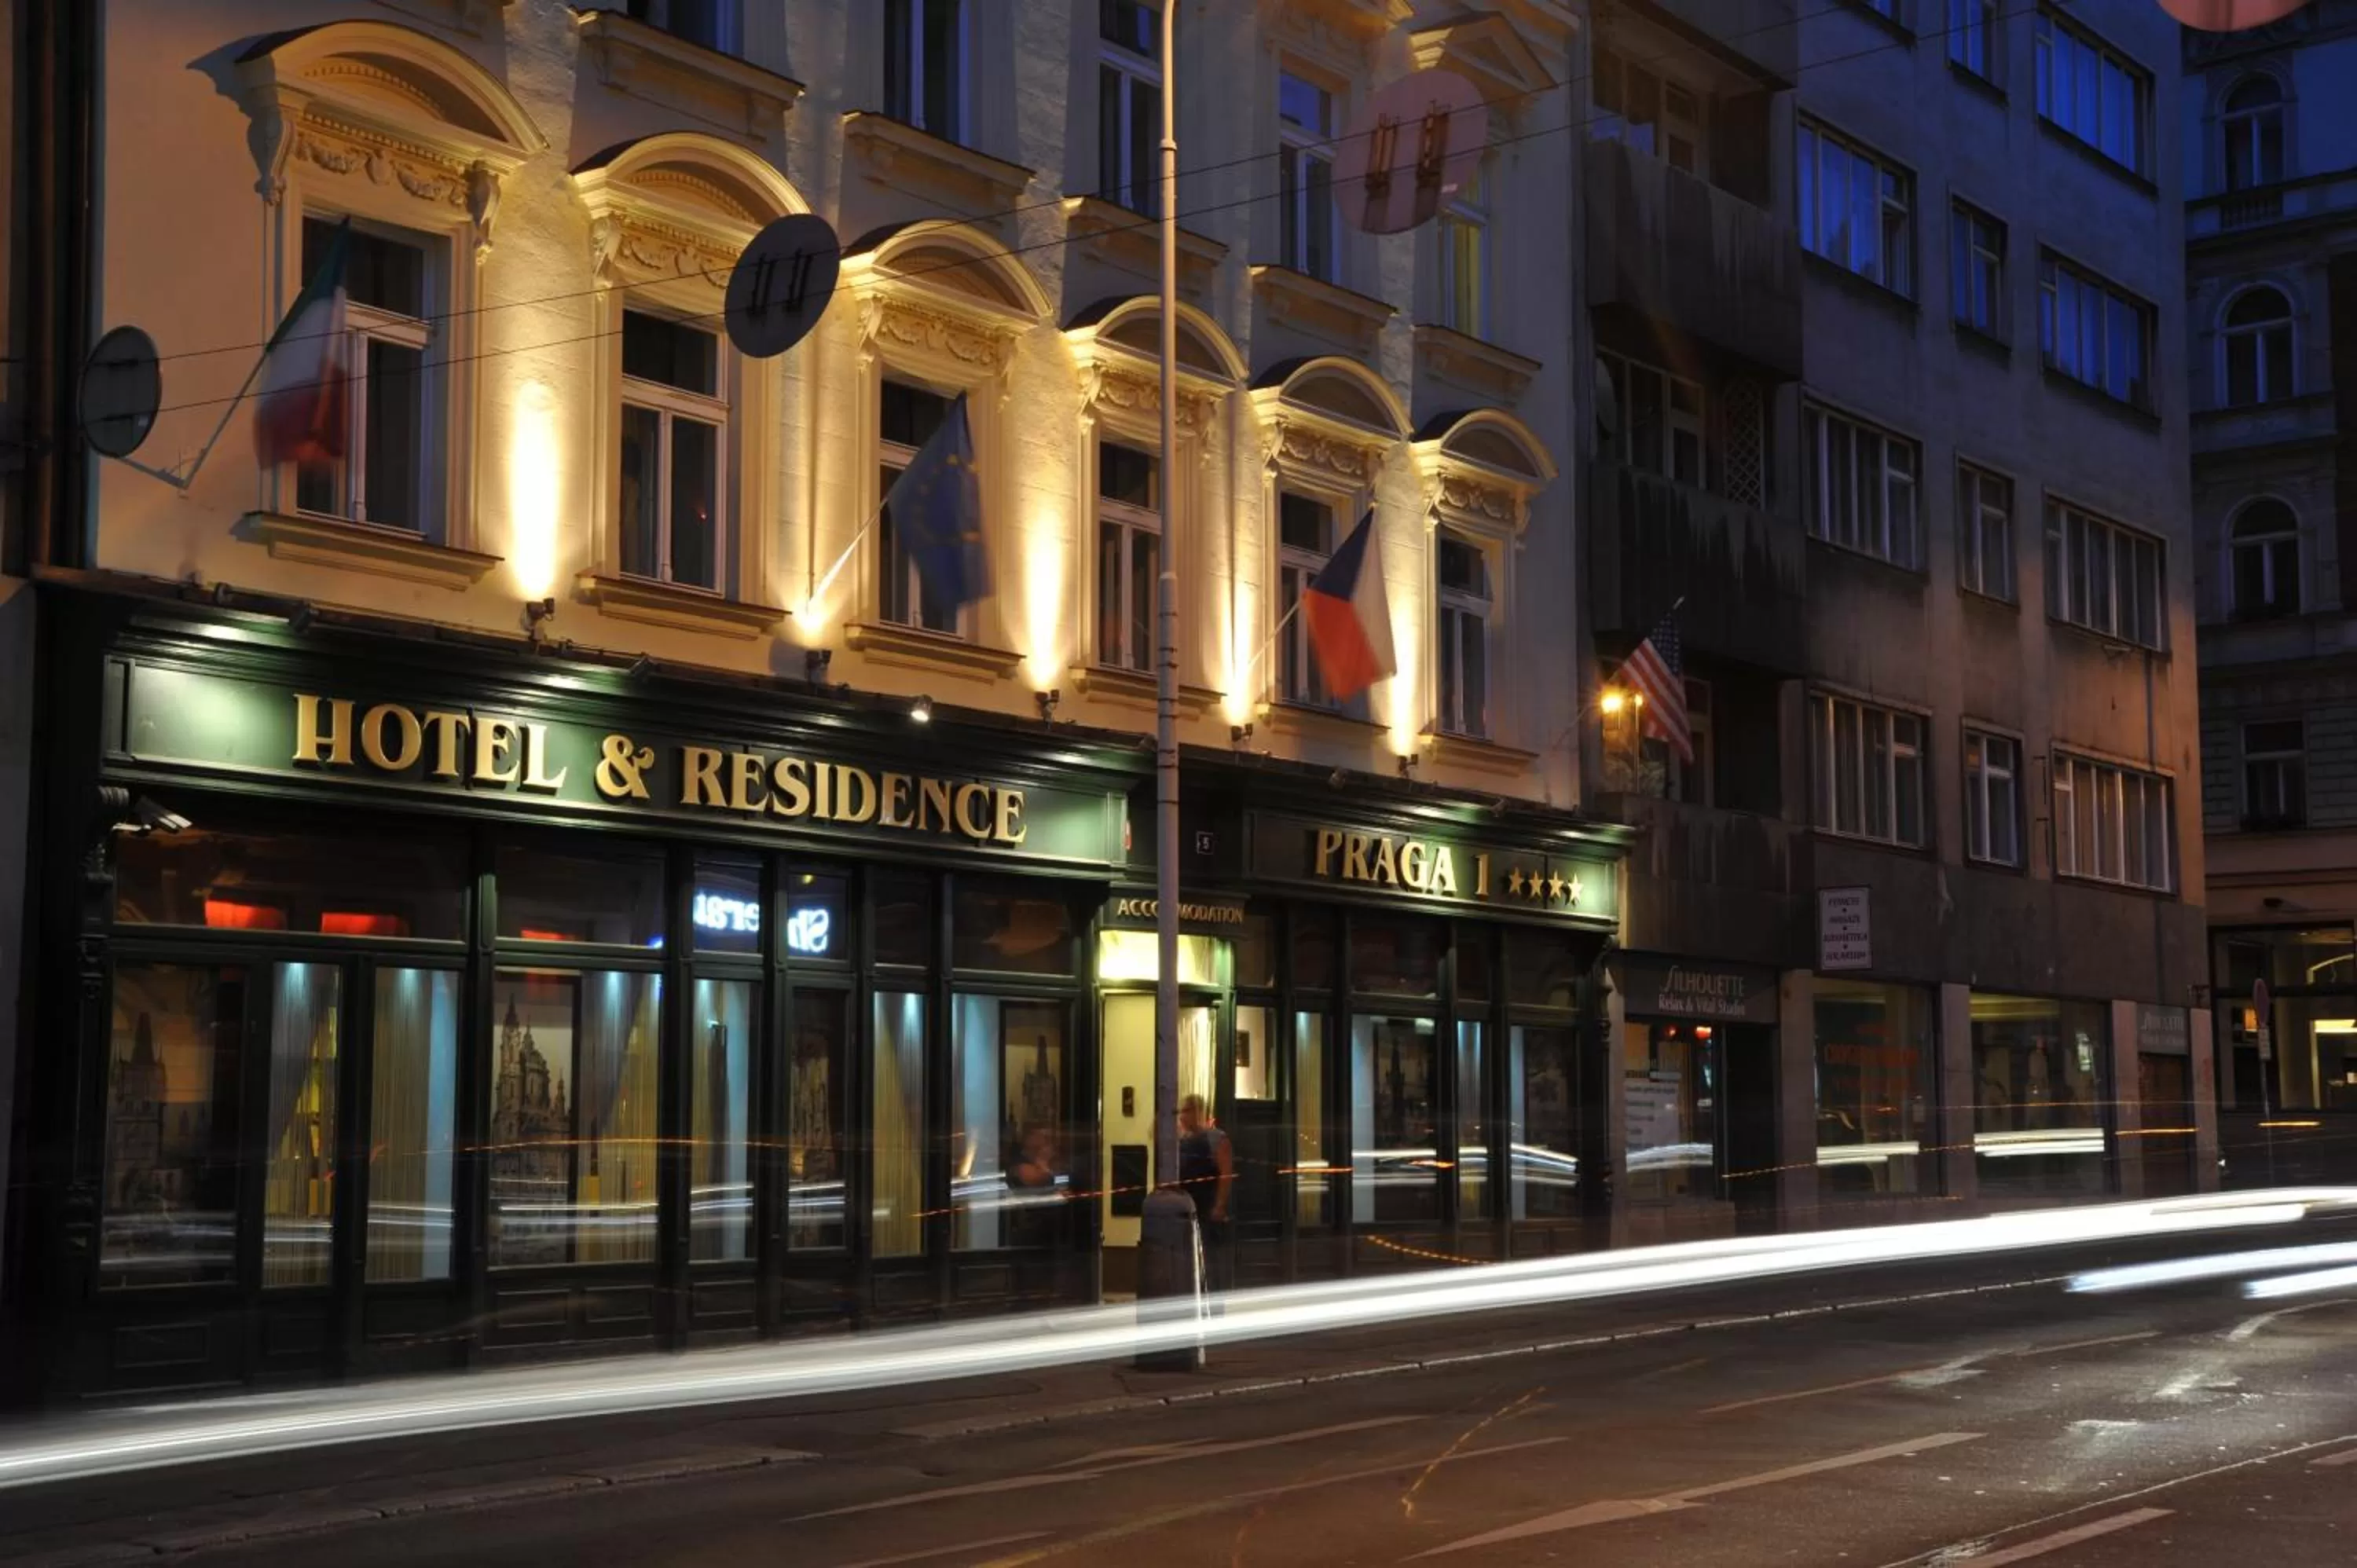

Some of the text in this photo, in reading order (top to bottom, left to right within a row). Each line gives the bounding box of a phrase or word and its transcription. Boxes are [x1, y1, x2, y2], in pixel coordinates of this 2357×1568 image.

[291, 694, 1027, 843] HOTEL & RESIDENCE
[1315, 829, 1458, 893] PRAGA
[1117, 898, 1244, 925] ACCOMODATION
[1659, 965, 1745, 997] SILHOUETTE
